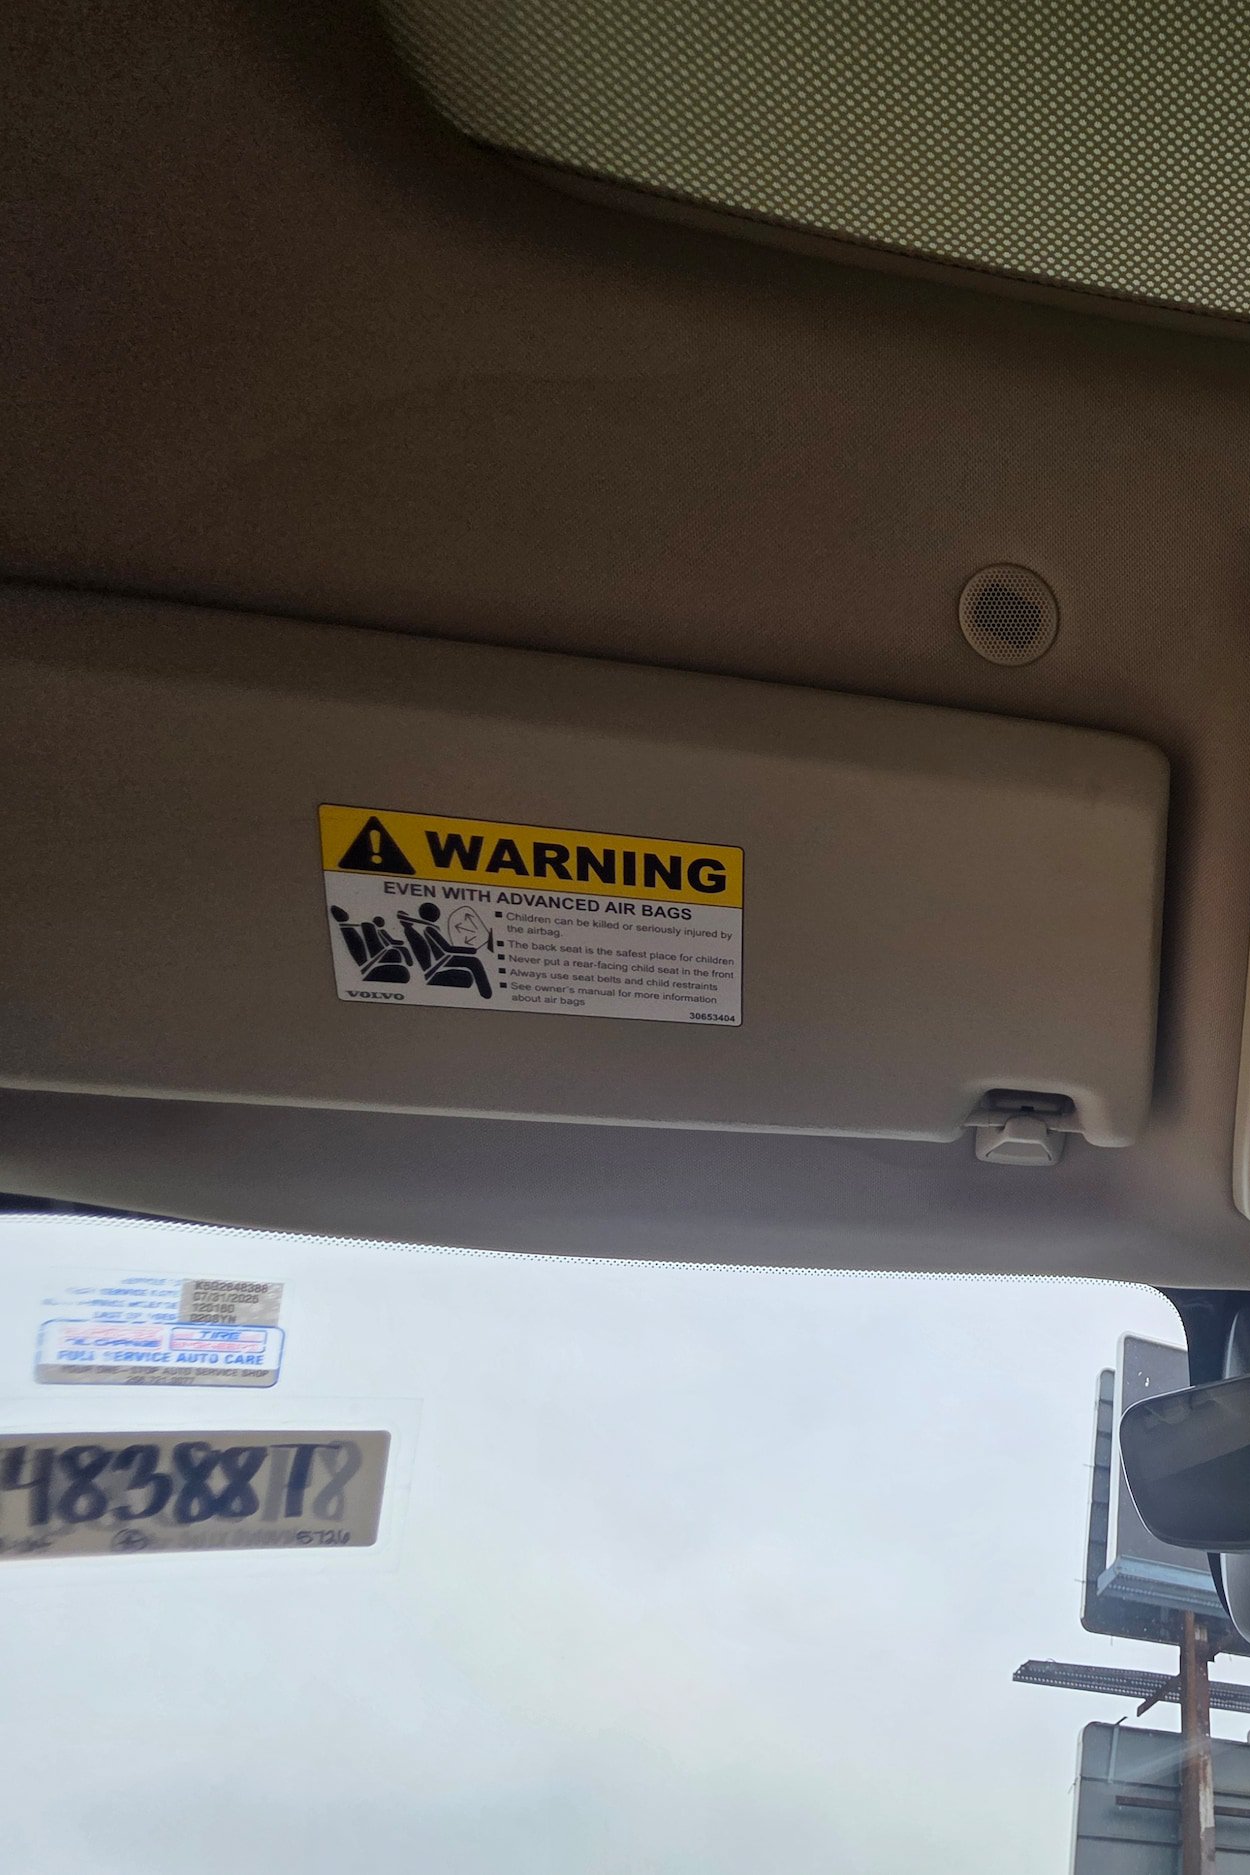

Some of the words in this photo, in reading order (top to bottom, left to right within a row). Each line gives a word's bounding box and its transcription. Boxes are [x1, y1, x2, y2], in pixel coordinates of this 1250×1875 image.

[425, 830, 727, 893] WARNING
[384, 881, 436, 898] EVEN
[442, 885, 491, 903] WITH
[497, 892, 600, 913] ADVANCED
[605, 900, 636, 916] AIR
[642, 904, 692, 920] BAGS
[506, 912, 551, 924] Children
[554, 917, 573, 926] can
[576, 918, 590, 927] be
[592, 920, 619, 929] killed
[622, 923, 633, 931] or
[636, 924, 681, 936] seriously
[684, 927, 718, 938] injured
[720, 931, 733, 941] by
[507, 925, 524, 934] the
[527, 927, 563, 938] airbag.
[508, 940, 529, 949] The
[531, 942, 557, 952] back
[560, 946, 582, 954] seat
[585, 947, 594, 955] is
[597, 947, 613, 956] the
[616, 949, 647, 959] safest
[649, 952, 677, 963] place
[680, 953, 693, 962] for
[695, 955, 735, 966] children
[508, 954, 541, 964] Never
[544, 958, 560, 967] put
[573, 960, 628, 973] rear-facing
[631, 963, 655, 973] child
[657, 966, 679, 975] seat
[682, 967, 691, 975] in
[693, 968, 709, 977] the
[711, 970, 734, 979] front
[510, 968, 547, 980] Always
[550, 972, 569, 980] use
[572, 974, 594, 982] seat
[597, 975, 621, 984] belts
[624, 977, 643, 985] and
[646, 978, 670, 987] child
[672, 981, 718, 991] restraints
[346, 990, 405, 1001] VOLVO
[510, 981, 532, 991] See
[578, 987, 615, 996] manual
[618, 989, 632, 998] for
[634, 991, 660, 999] more
[663, 993, 717, 1004] information
[511, 994, 541, 1003] about
[544, 996, 557, 1004] air
[560, 997, 585, 1007] bags
[689, 1012, 735, 1022] 30653404
[198, 1330, 241, 1340] TIRE
[102, 1350, 170, 1362] SERVICE
[176, 1352, 218, 1364] AUTO
[224, 1354, 264, 1365] CARE
[195, 1368, 238, 1377] SERVICE
[241, 1368, 269, 1378] SHOP
